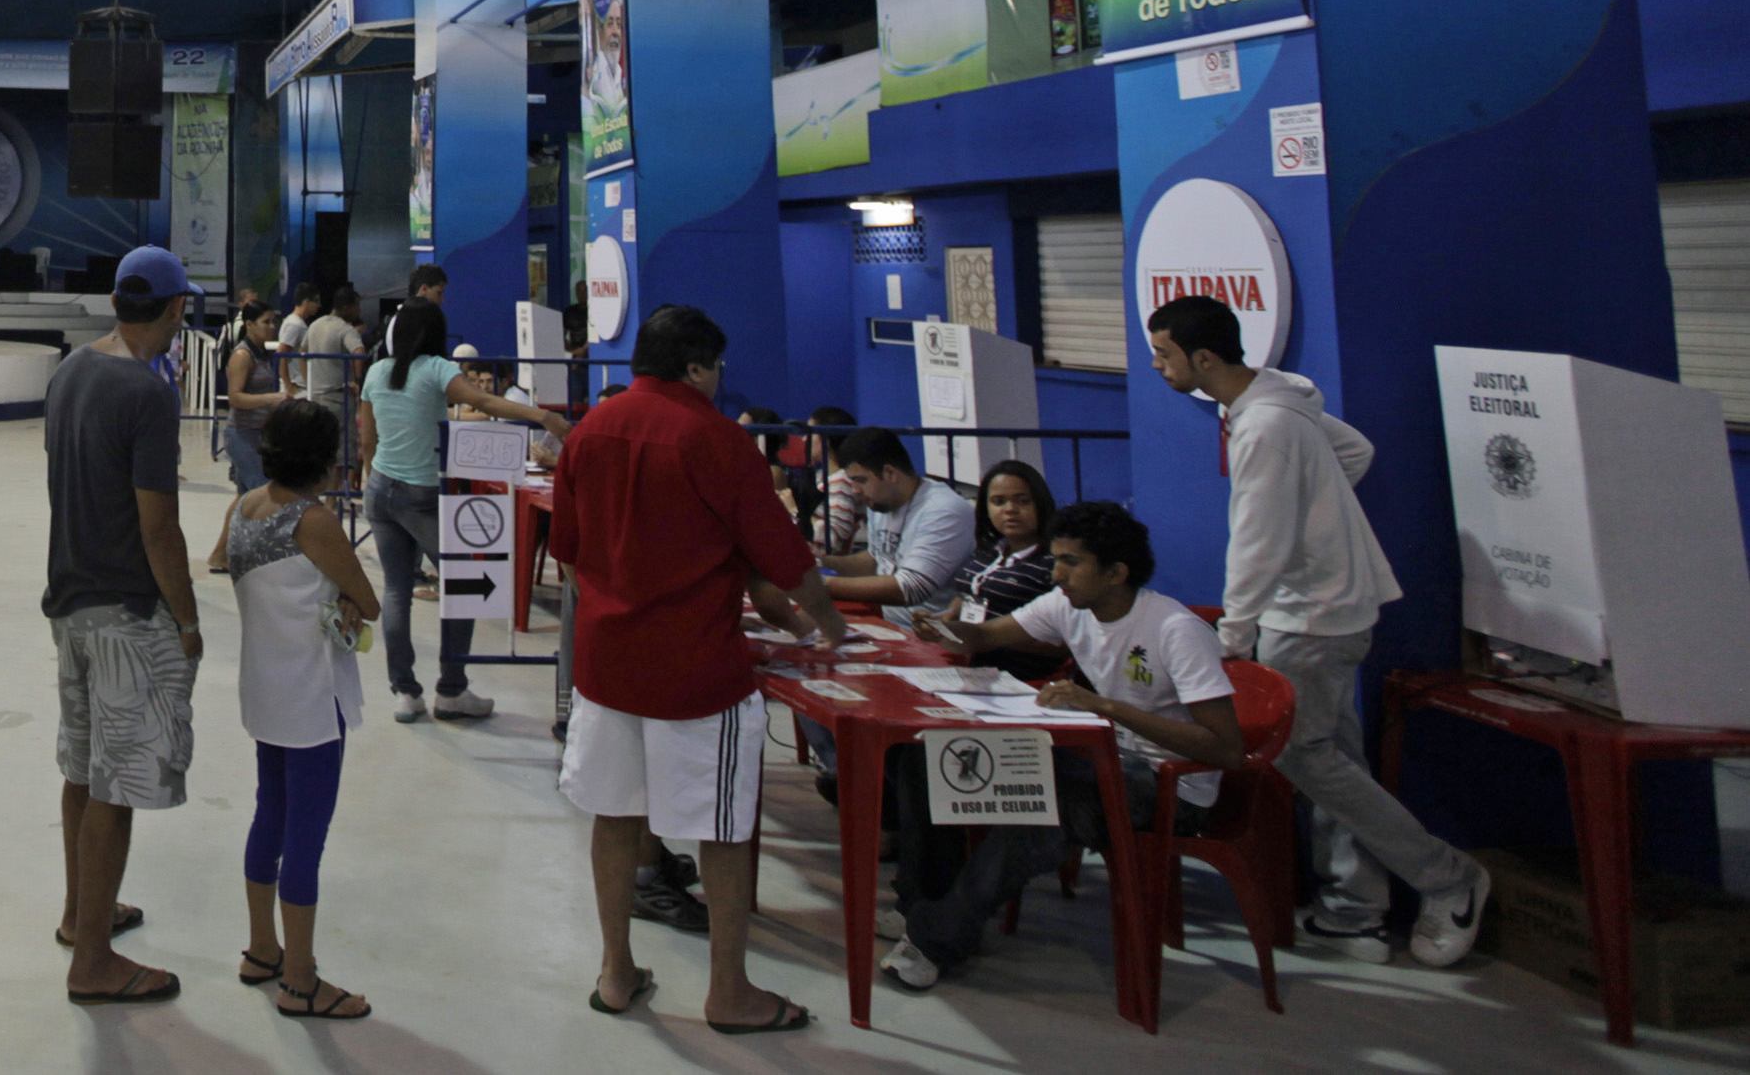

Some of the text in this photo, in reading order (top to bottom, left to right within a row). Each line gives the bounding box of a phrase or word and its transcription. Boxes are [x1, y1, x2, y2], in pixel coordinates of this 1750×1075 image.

[172, 49, 205, 66] 22
[1473, 371, 1529, 397] JUSTIÇA
[1469, 395, 1541, 419] ELEITORAL
[456, 434, 517, 466] 246
[1491, 545, 1553, 570] CABINA DE
[993, 784, 1044, 796] PROIBIDO
[952, 800, 1047, 814] O USO DE CELULAR
